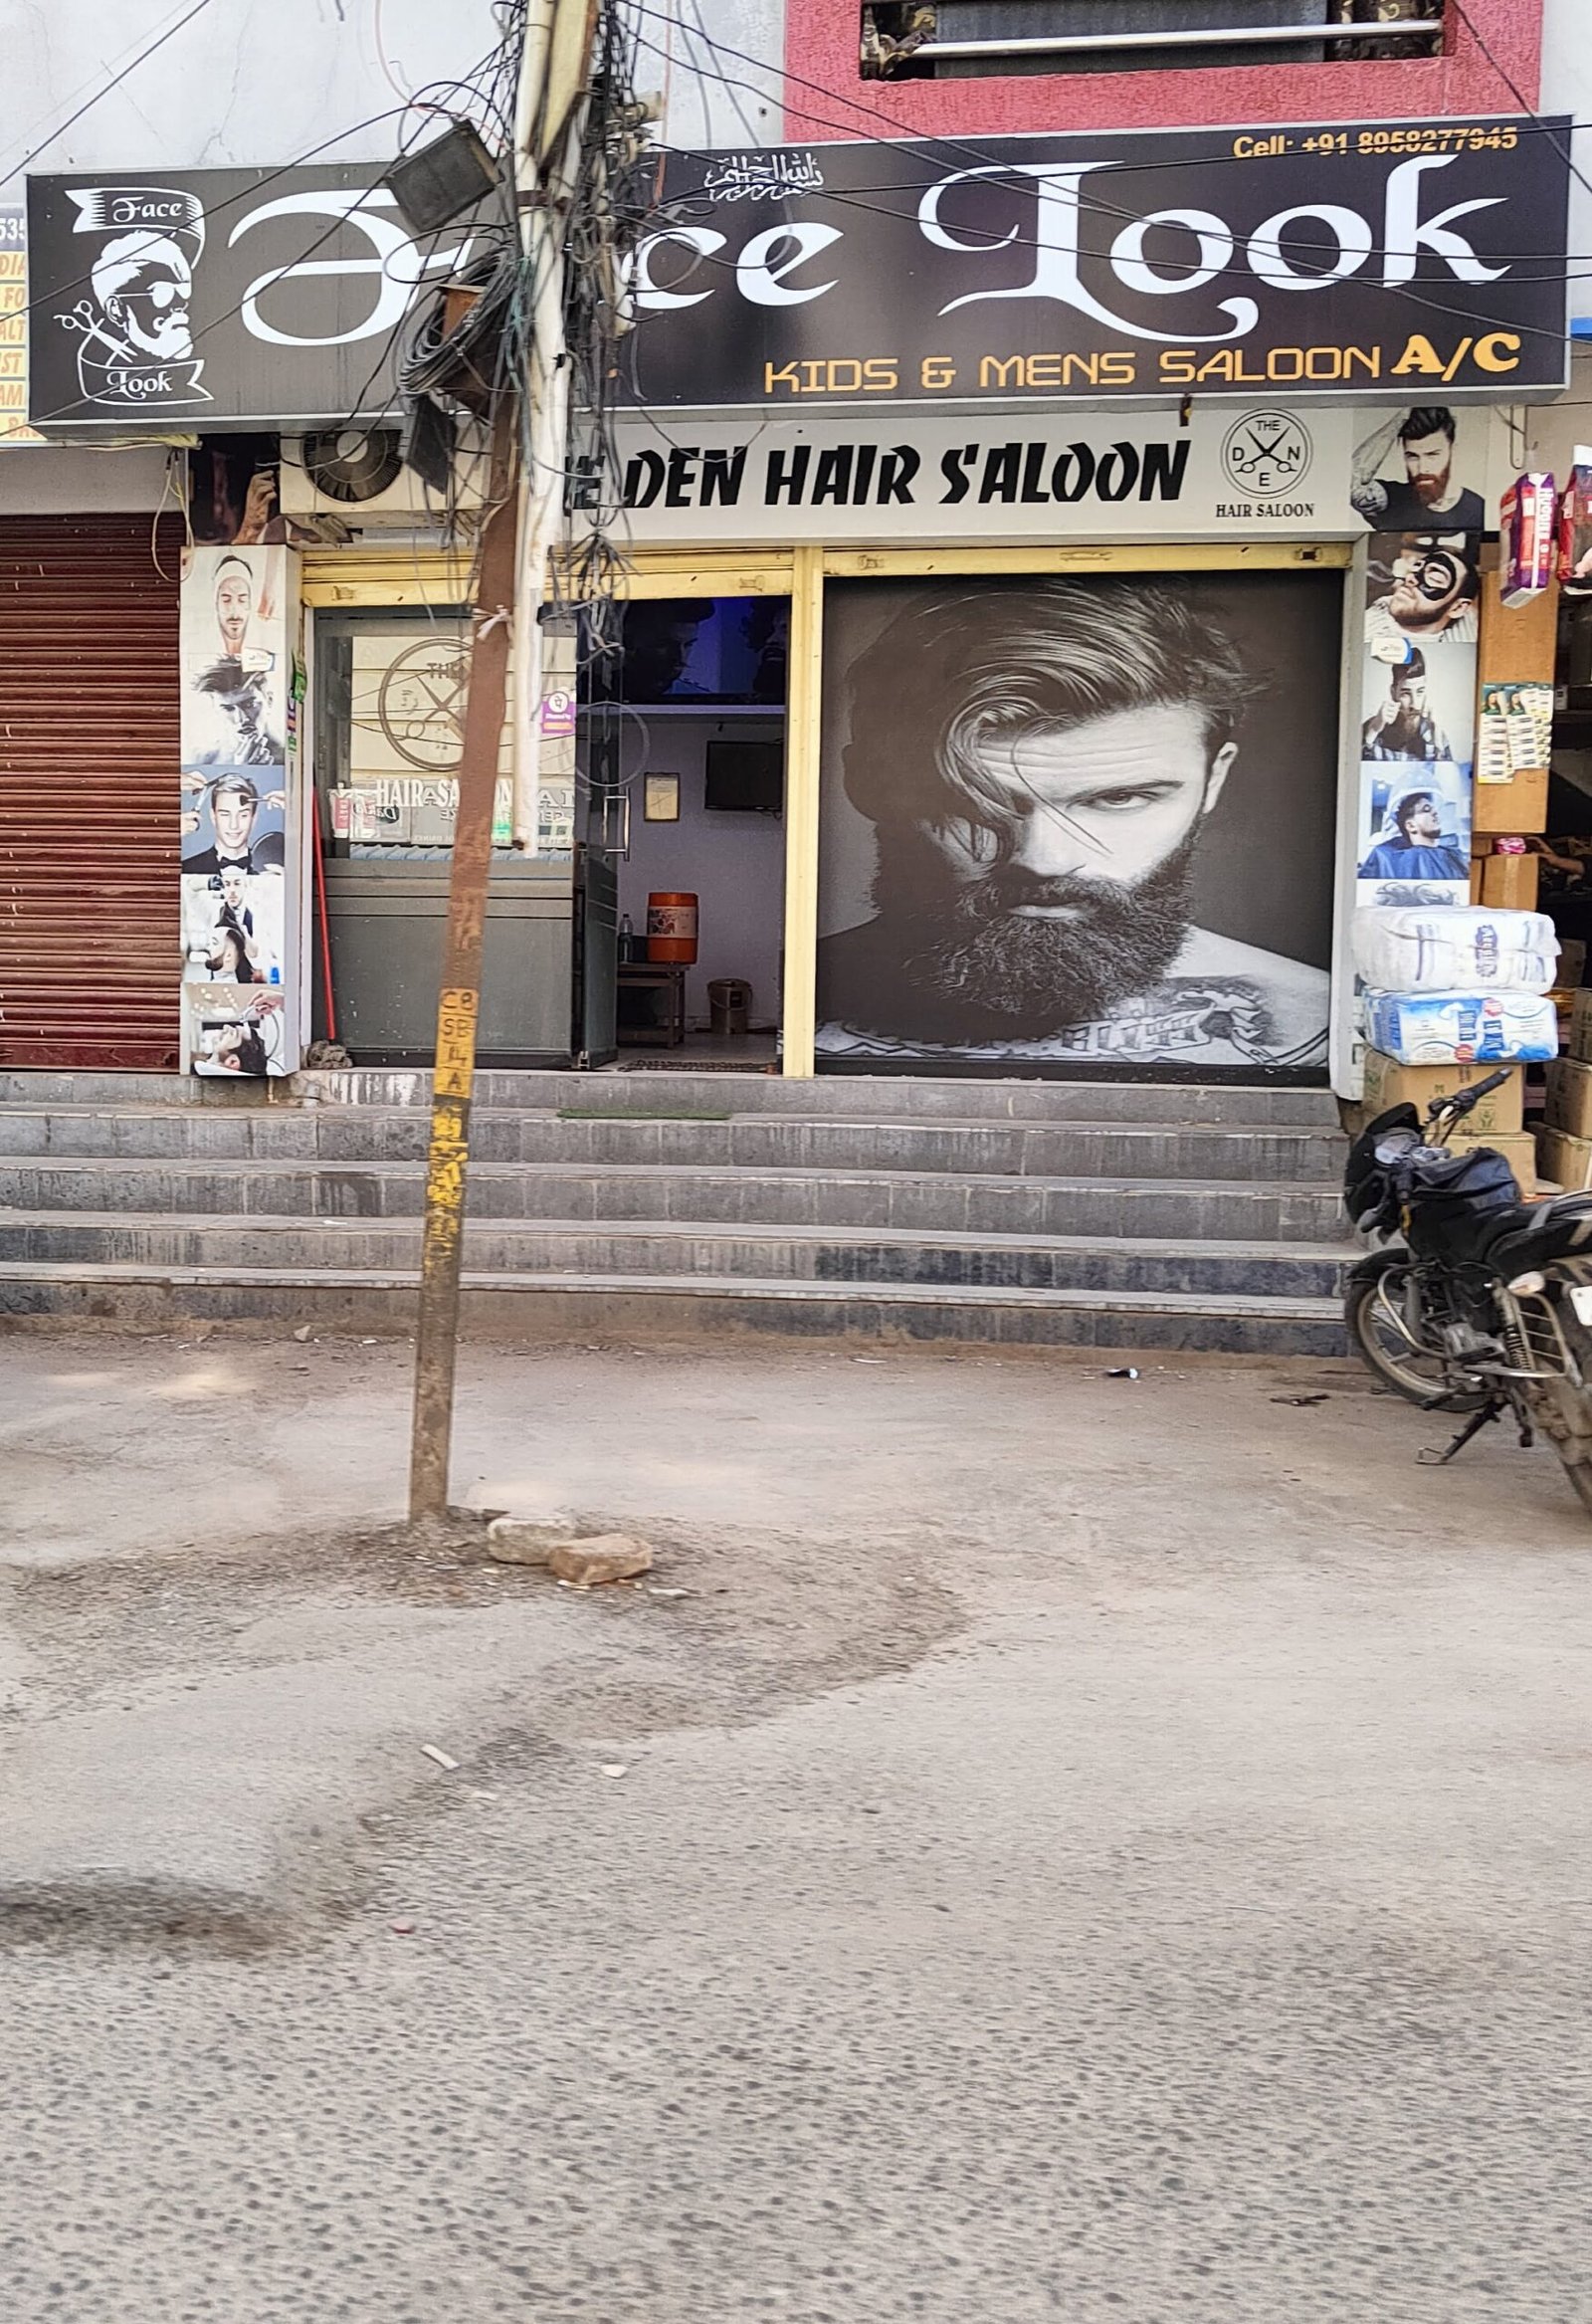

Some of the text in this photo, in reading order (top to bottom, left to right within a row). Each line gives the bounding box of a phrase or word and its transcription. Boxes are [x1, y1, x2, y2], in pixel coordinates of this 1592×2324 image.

[1301, 131, 1348, 156] +91
[112, 196, 183, 223] Face
[227, 153, 1512, 346] Fce Look
[764, 331, 1521, 393] KIDS & MENS SALOON A/C
[106, 370, 174, 399] Look
[1255, 419, 1282, 431] THE
[1232, 446, 1246, 462] D
[1287, 446, 1301, 461] N
[623, 445, 749, 509] DEN
[763, 443, 922, 507] HAIR
[938, 438, 1192, 506] SALOON
[1258, 472, 1272, 487] E
[1215, 503, 1315, 518] HAIR SALOON
[375, 778, 424, 807] HAIR
